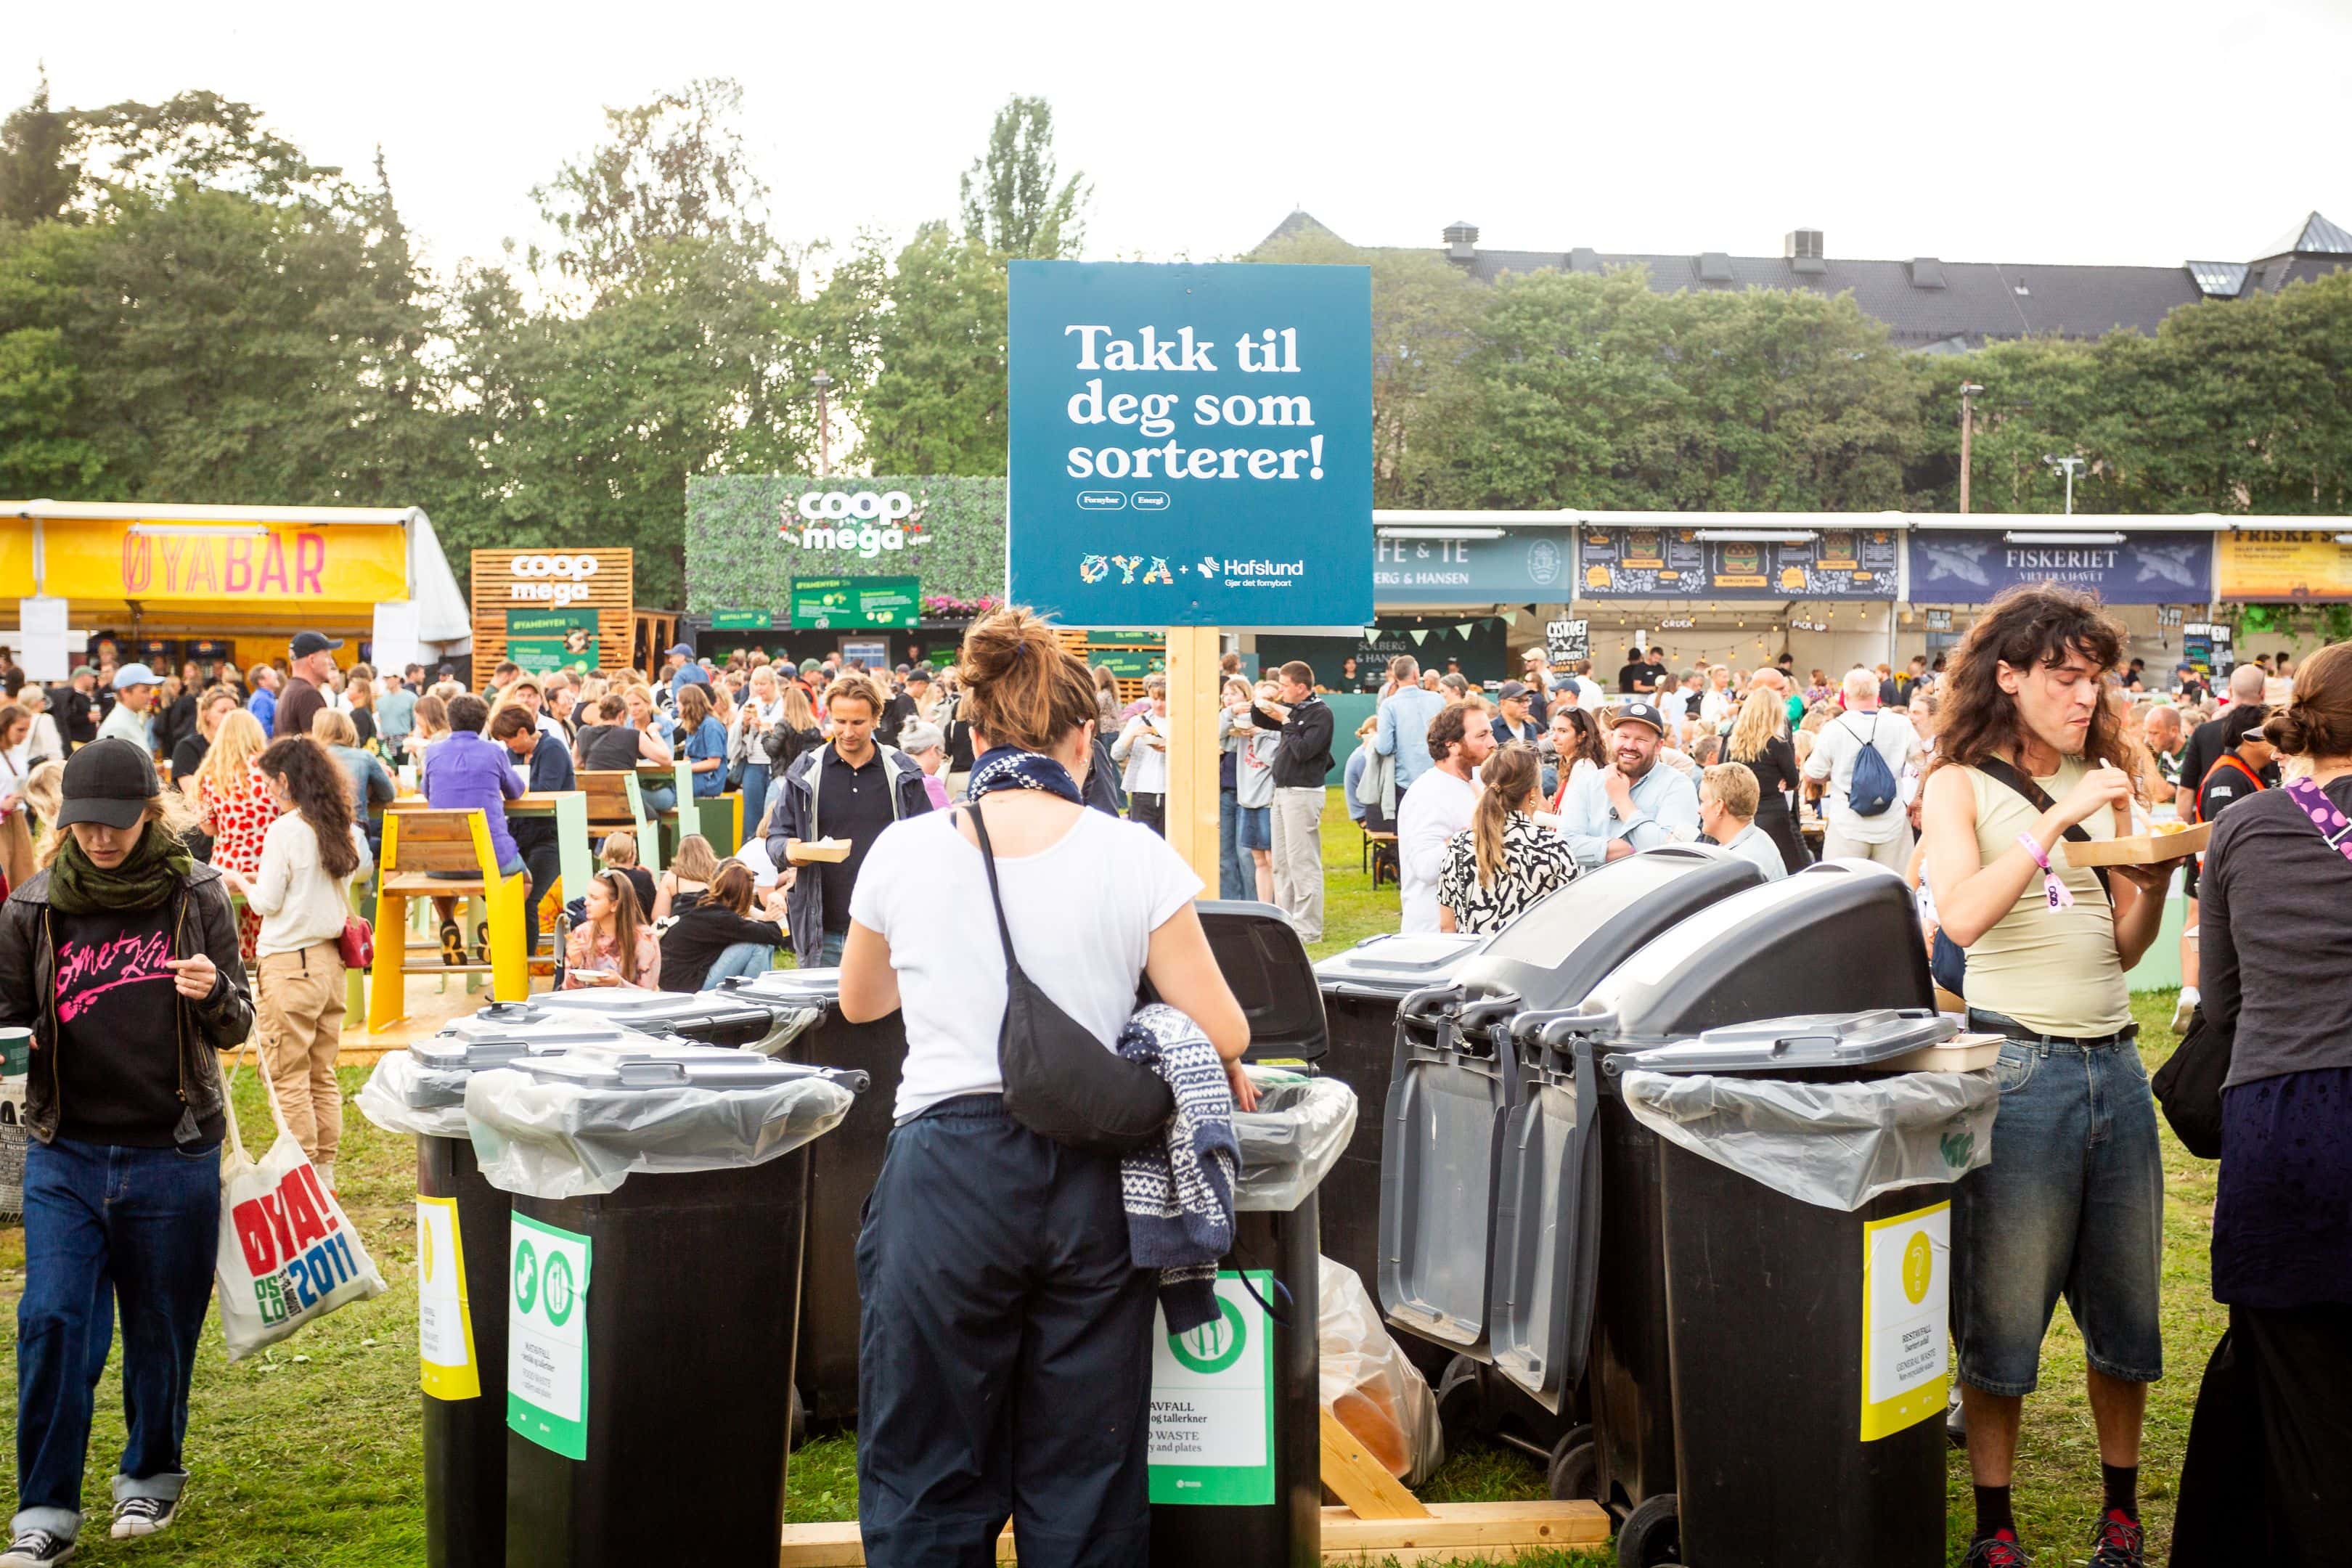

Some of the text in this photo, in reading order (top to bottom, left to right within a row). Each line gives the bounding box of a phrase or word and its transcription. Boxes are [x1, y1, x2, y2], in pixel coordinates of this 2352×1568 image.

[1064, 324, 1302, 372] Takk til
[1066, 377, 1315, 438] deg som
[1066, 433, 1324, 481] sorterer!
[798, 491, 912, 526] coop
[1138, 497, 1164, 505] Energi
[802, 525, 904, 558] mega
[1373, 539, 1469, 563] FE & TE
[510, 555, 598, 581] coop
[1224, 559, 1304, 576] Hafslund
[2006, 550, 2119, 569] FISKERIET
[1225, 579, 1241, 588] Gjør
[1257, 579, 1292, 588] fornybart
[1403, 573, 1413, 584] &
[1416, 572, 1469, 584] HANSEN
[510, 582, 589, 607] mega
[1792, 619, 1813, 630] PICK
[1358, 641, 1406, 651] SOLBERG
[1356, 654, 1390, 663] & HAN
[232, 1163, 339, 1278] ØYA!
[287, 1231, 359, 1310] 2011
[254, 1275, 281, 1300] OS
[258, 1298, 286, 1324] LO
[1151, 1413, 1208, 1424] og tallerkner
[1155, 1431, 1200, 1441] WASTE
[1156, 1442, 1173, 1452] and
[1175, 1442, 1202, 1454] plates
